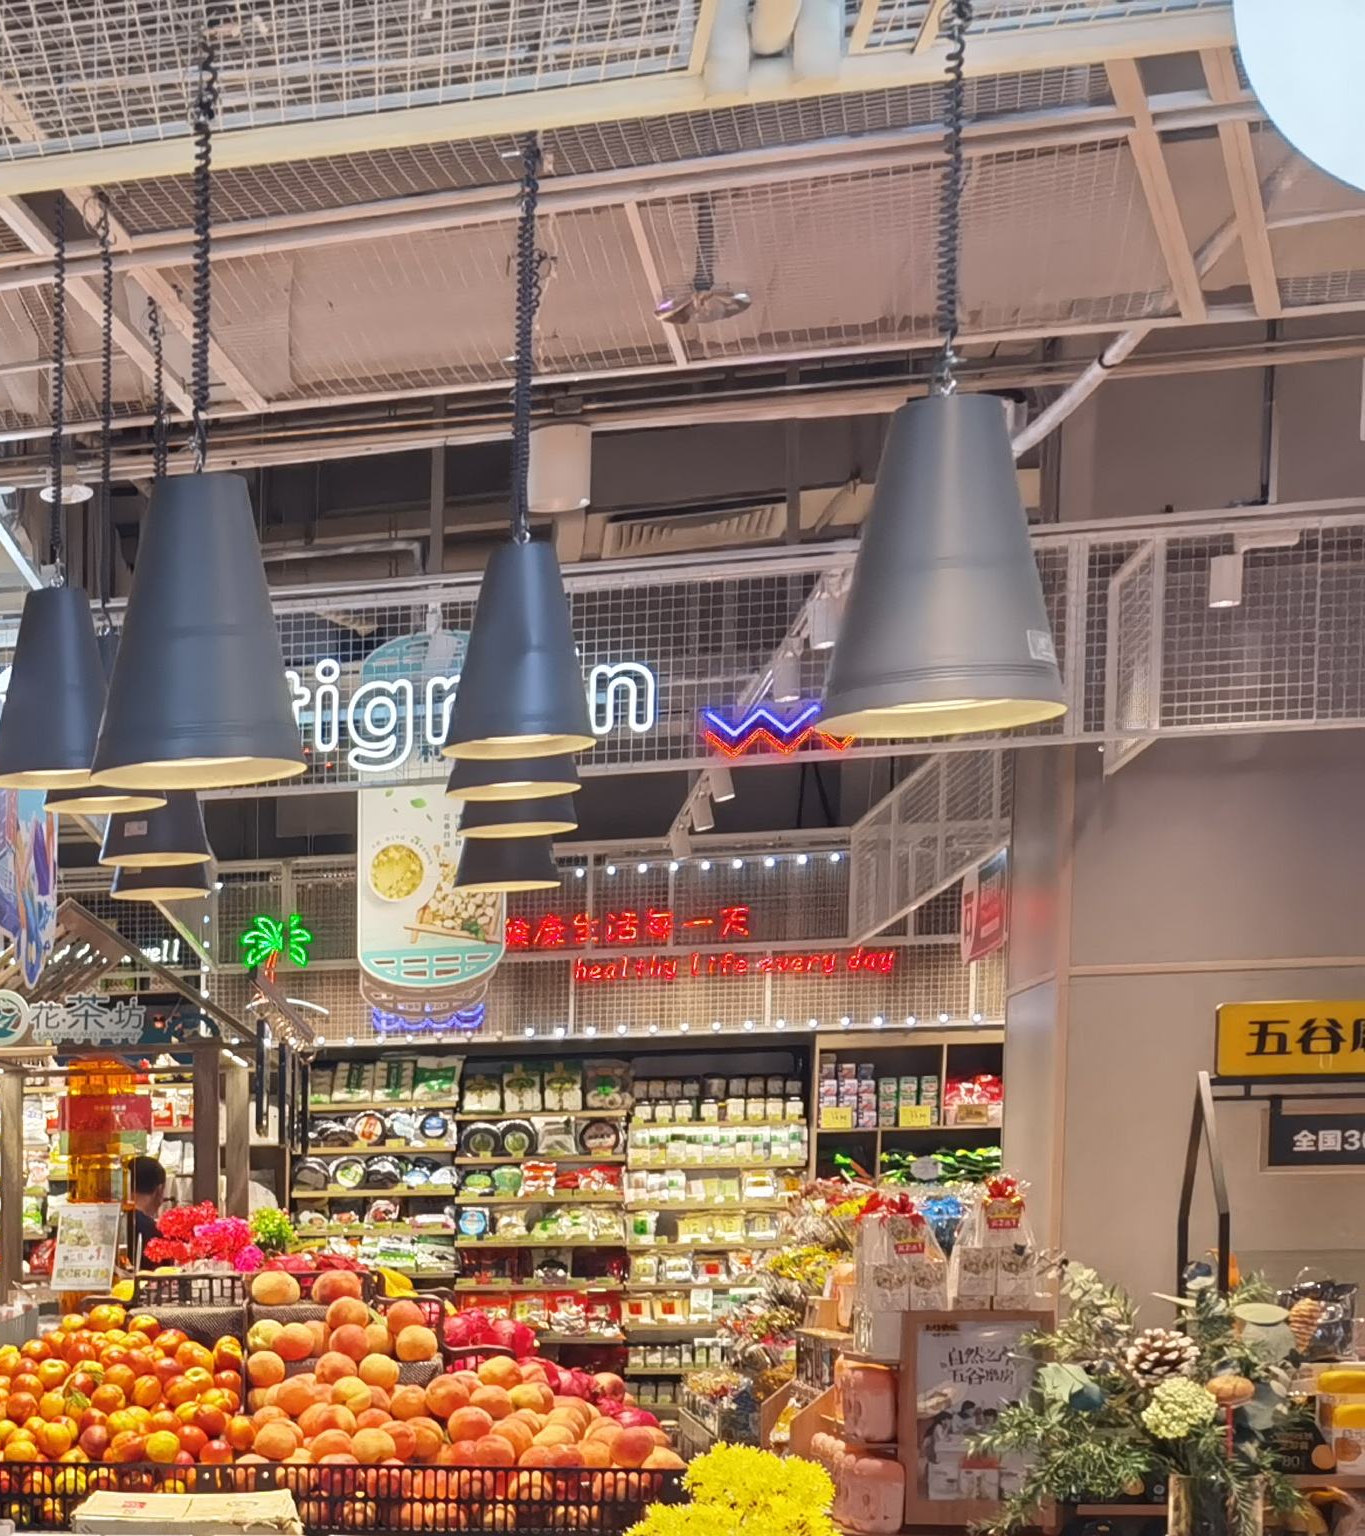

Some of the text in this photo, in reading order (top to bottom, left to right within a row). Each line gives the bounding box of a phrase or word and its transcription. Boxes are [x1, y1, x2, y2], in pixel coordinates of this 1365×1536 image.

[574, 953, 678, 981] healthy
[757, 954, 836, 977] every
[847, 944, 896, 974] day
[1292, 1129, 1365, 1152] 全国3
